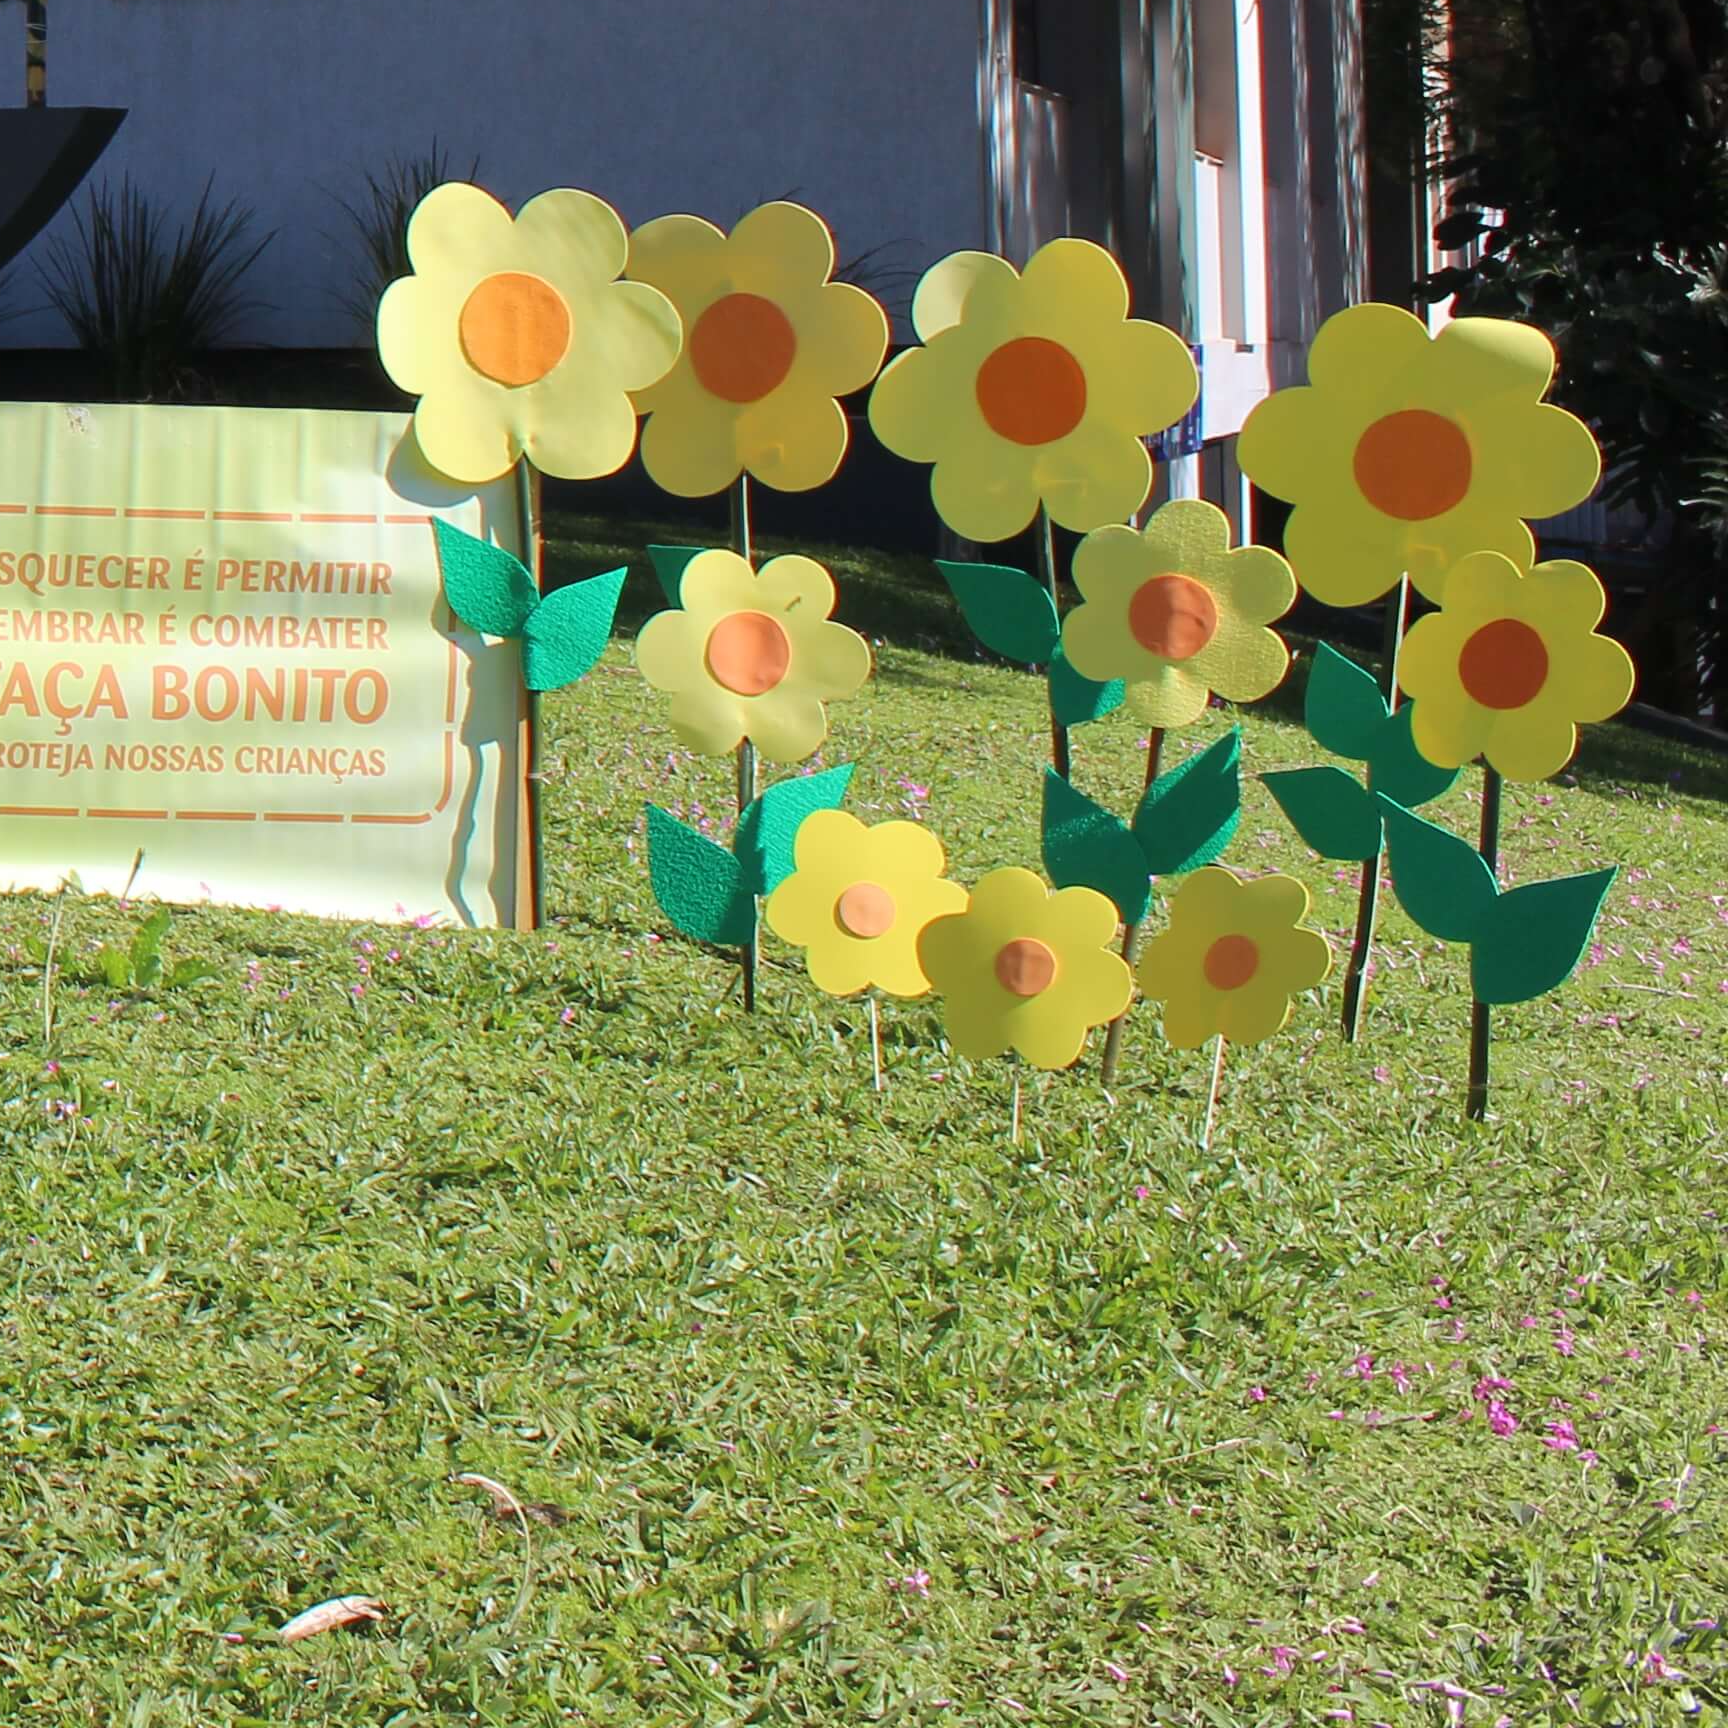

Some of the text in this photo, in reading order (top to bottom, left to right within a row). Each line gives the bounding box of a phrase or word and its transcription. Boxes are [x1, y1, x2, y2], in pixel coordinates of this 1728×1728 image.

[182, 549, 205, 591] É
[216, 558, 393, 596] PERMITIR
[158, 605, 178, 646] É
[189, 613, 390, 650] COMBATER
[152, 663, 390, 725] BONITO
[104, 742, 225, 774] NOSSAS
[234, 744, 387, 784] CRIANÇAS
